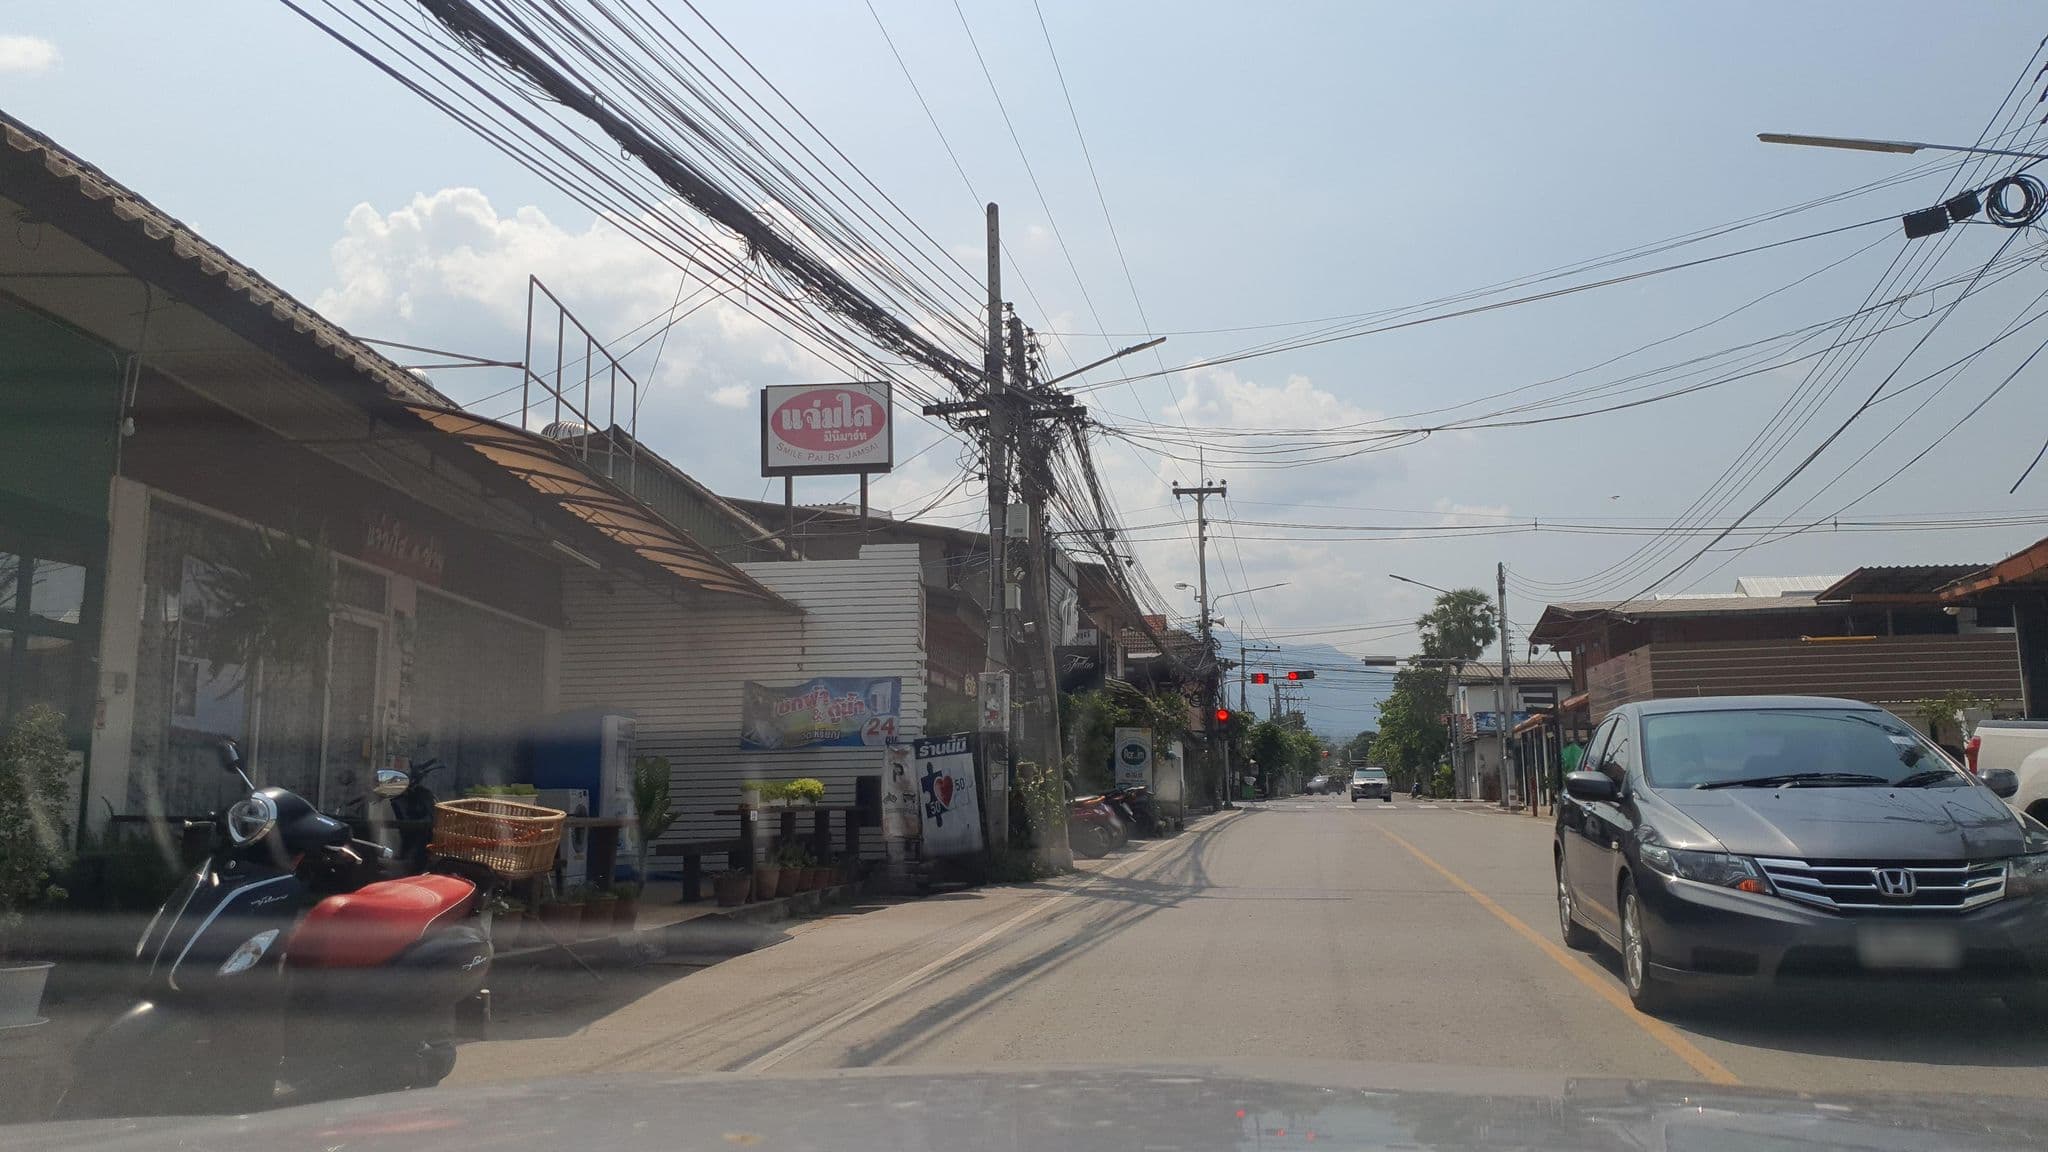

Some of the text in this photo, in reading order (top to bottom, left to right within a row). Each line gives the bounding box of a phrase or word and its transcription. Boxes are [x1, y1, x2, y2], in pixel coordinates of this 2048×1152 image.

[782, 393, 873, 430] แจ่มใส
[867, 717, 895, 736] 24
[919, 736, 967, 757] ร้านนี้มี
